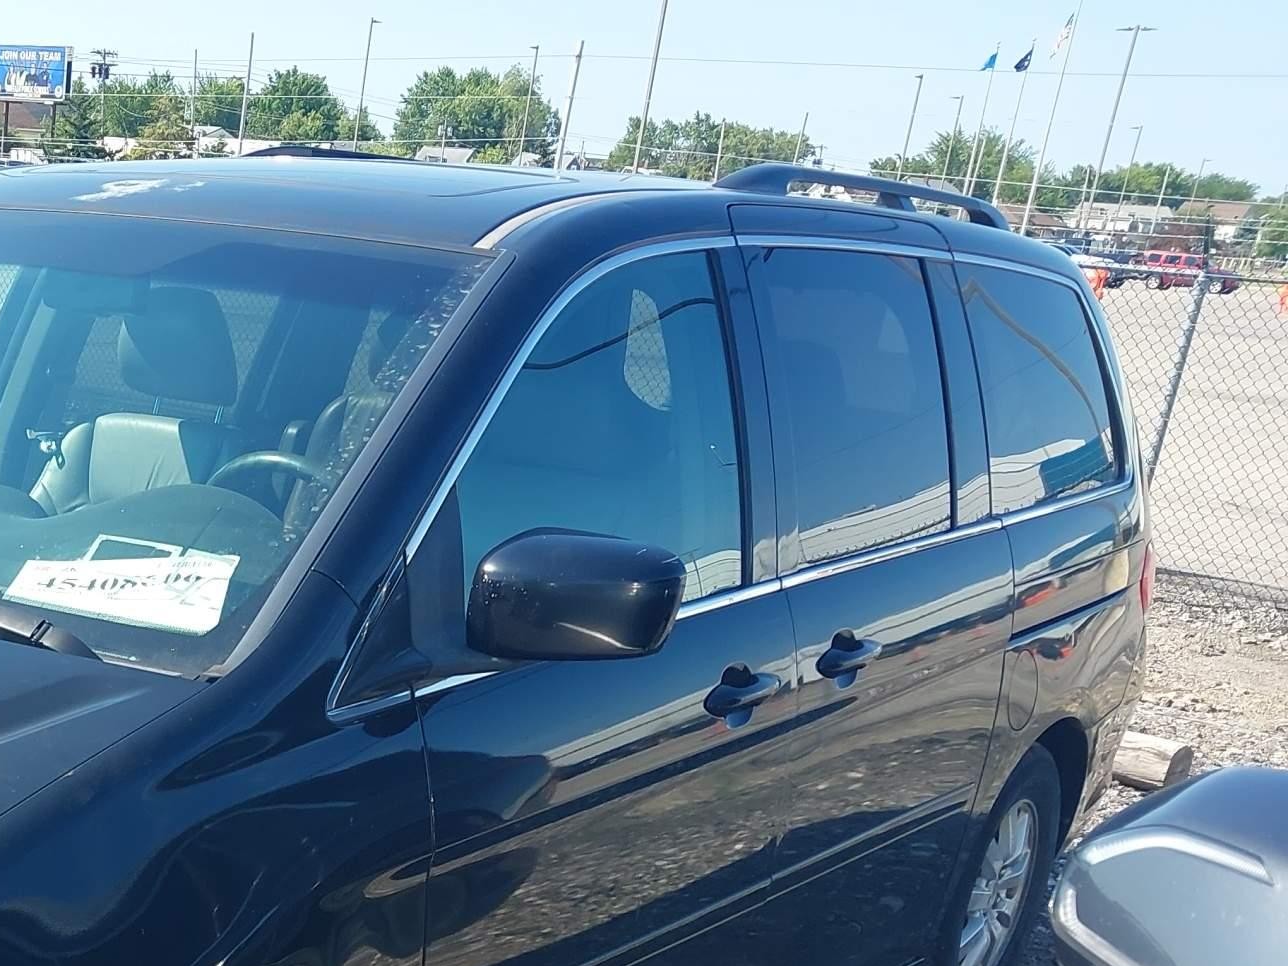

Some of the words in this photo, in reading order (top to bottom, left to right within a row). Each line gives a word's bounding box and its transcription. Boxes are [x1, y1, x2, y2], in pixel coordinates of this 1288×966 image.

[0, 50, 18, 60] JOIN
[19, 51, 37, 61] OUR
[38, 51, 61, 61] TEAM
